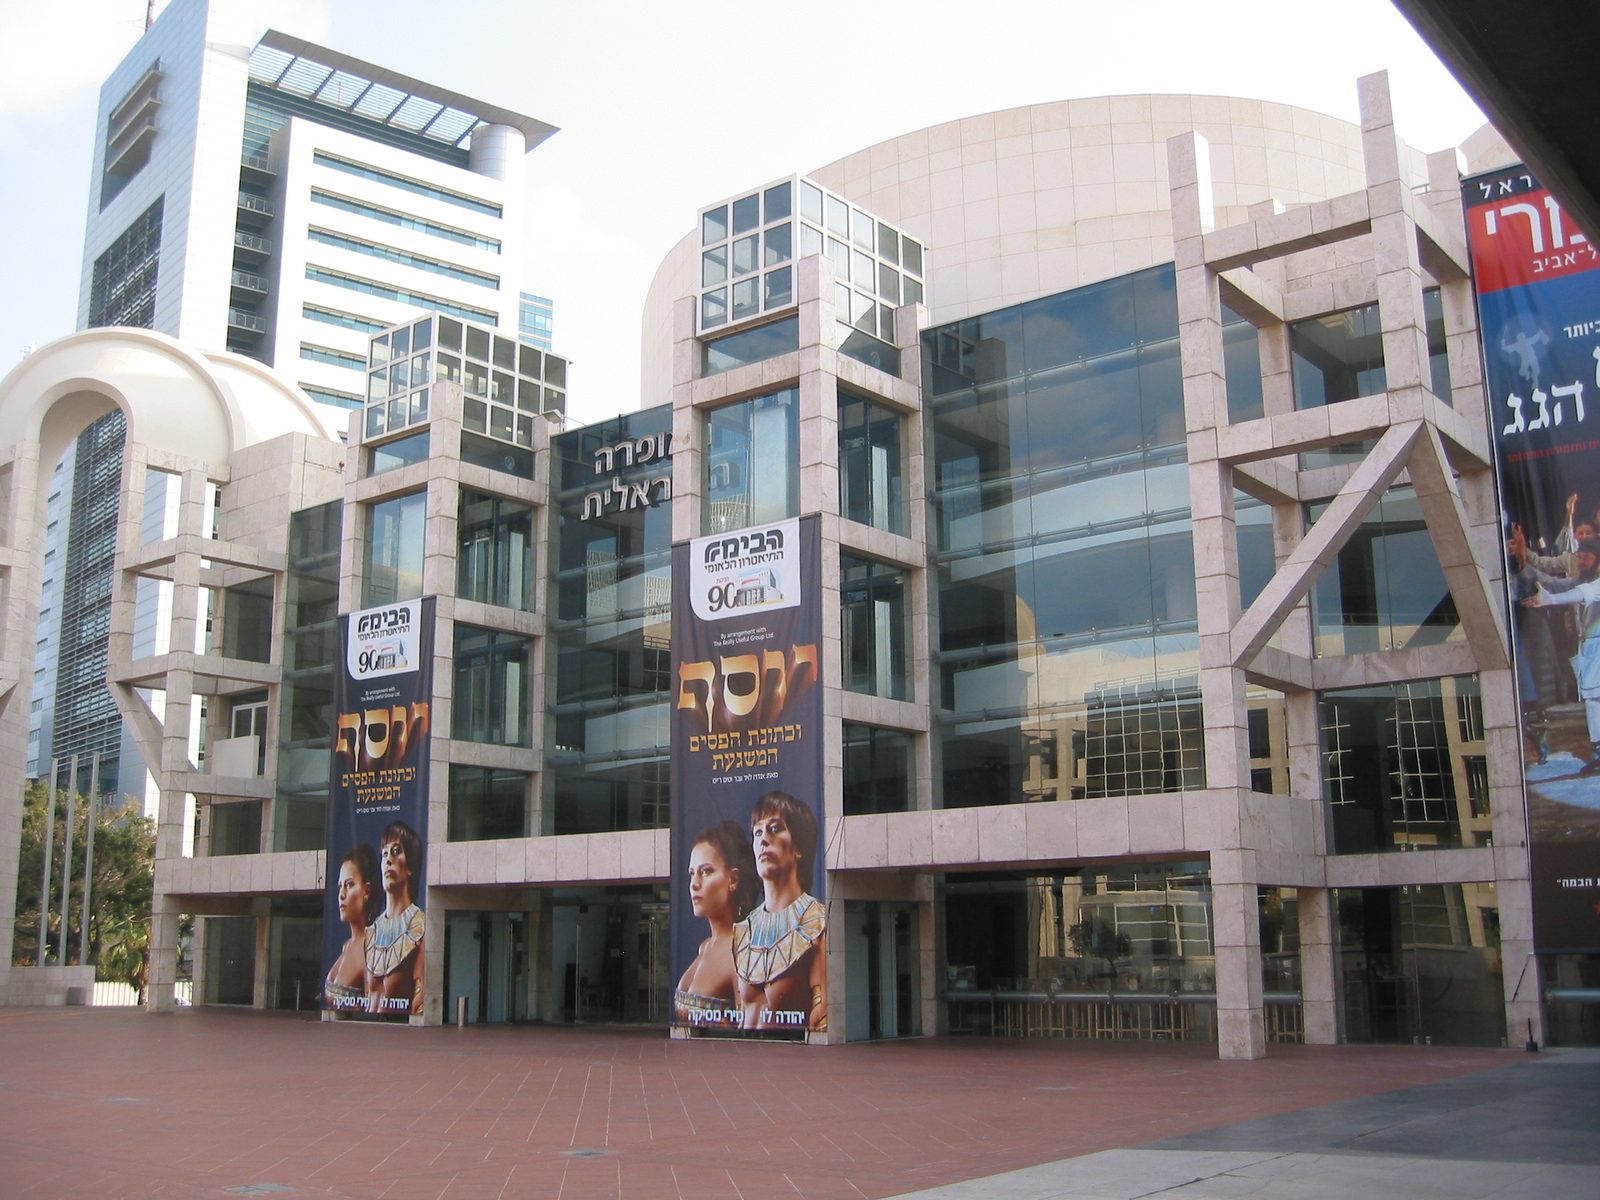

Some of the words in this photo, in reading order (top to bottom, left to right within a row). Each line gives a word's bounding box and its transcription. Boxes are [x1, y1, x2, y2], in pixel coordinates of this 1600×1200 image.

[1480, 175, 1532, 199] ראל
[1485, 196, 1587, 254] ורי
[1533, 244, 1597, 273] ל-אביב
[1503, 380, 1585, 436] הגג
[594, 431, 673, 475] ופרה
[580, 475, 671, 521] ראלית
[704, 560, 737, 574] הלאומי
[739, 551, 784, 569] התיאטרון
[708, 582, 737, 613] 90
[359, 649, 378, 673] 90
[677, 643, 818, 733] יוסף
[336, 702, 429, 773] יוסף
[689, 731, 741, 752] הפסים
[748, 724, 803, 746] וכתונת
[712, 748, 778, 772] המשגעת
[342, 771, 375, 788] הפסים
[380, 767, 416, 784] וכתונת
[356, 786, 401, 804] המשגעת
[688, 1008, 721, 1026] מסיקה
[724, 1009, 744, 1022] מירי
[760, 1007, 773, 1023] לוי
[775, 1010, 805, 1024] יהודה
